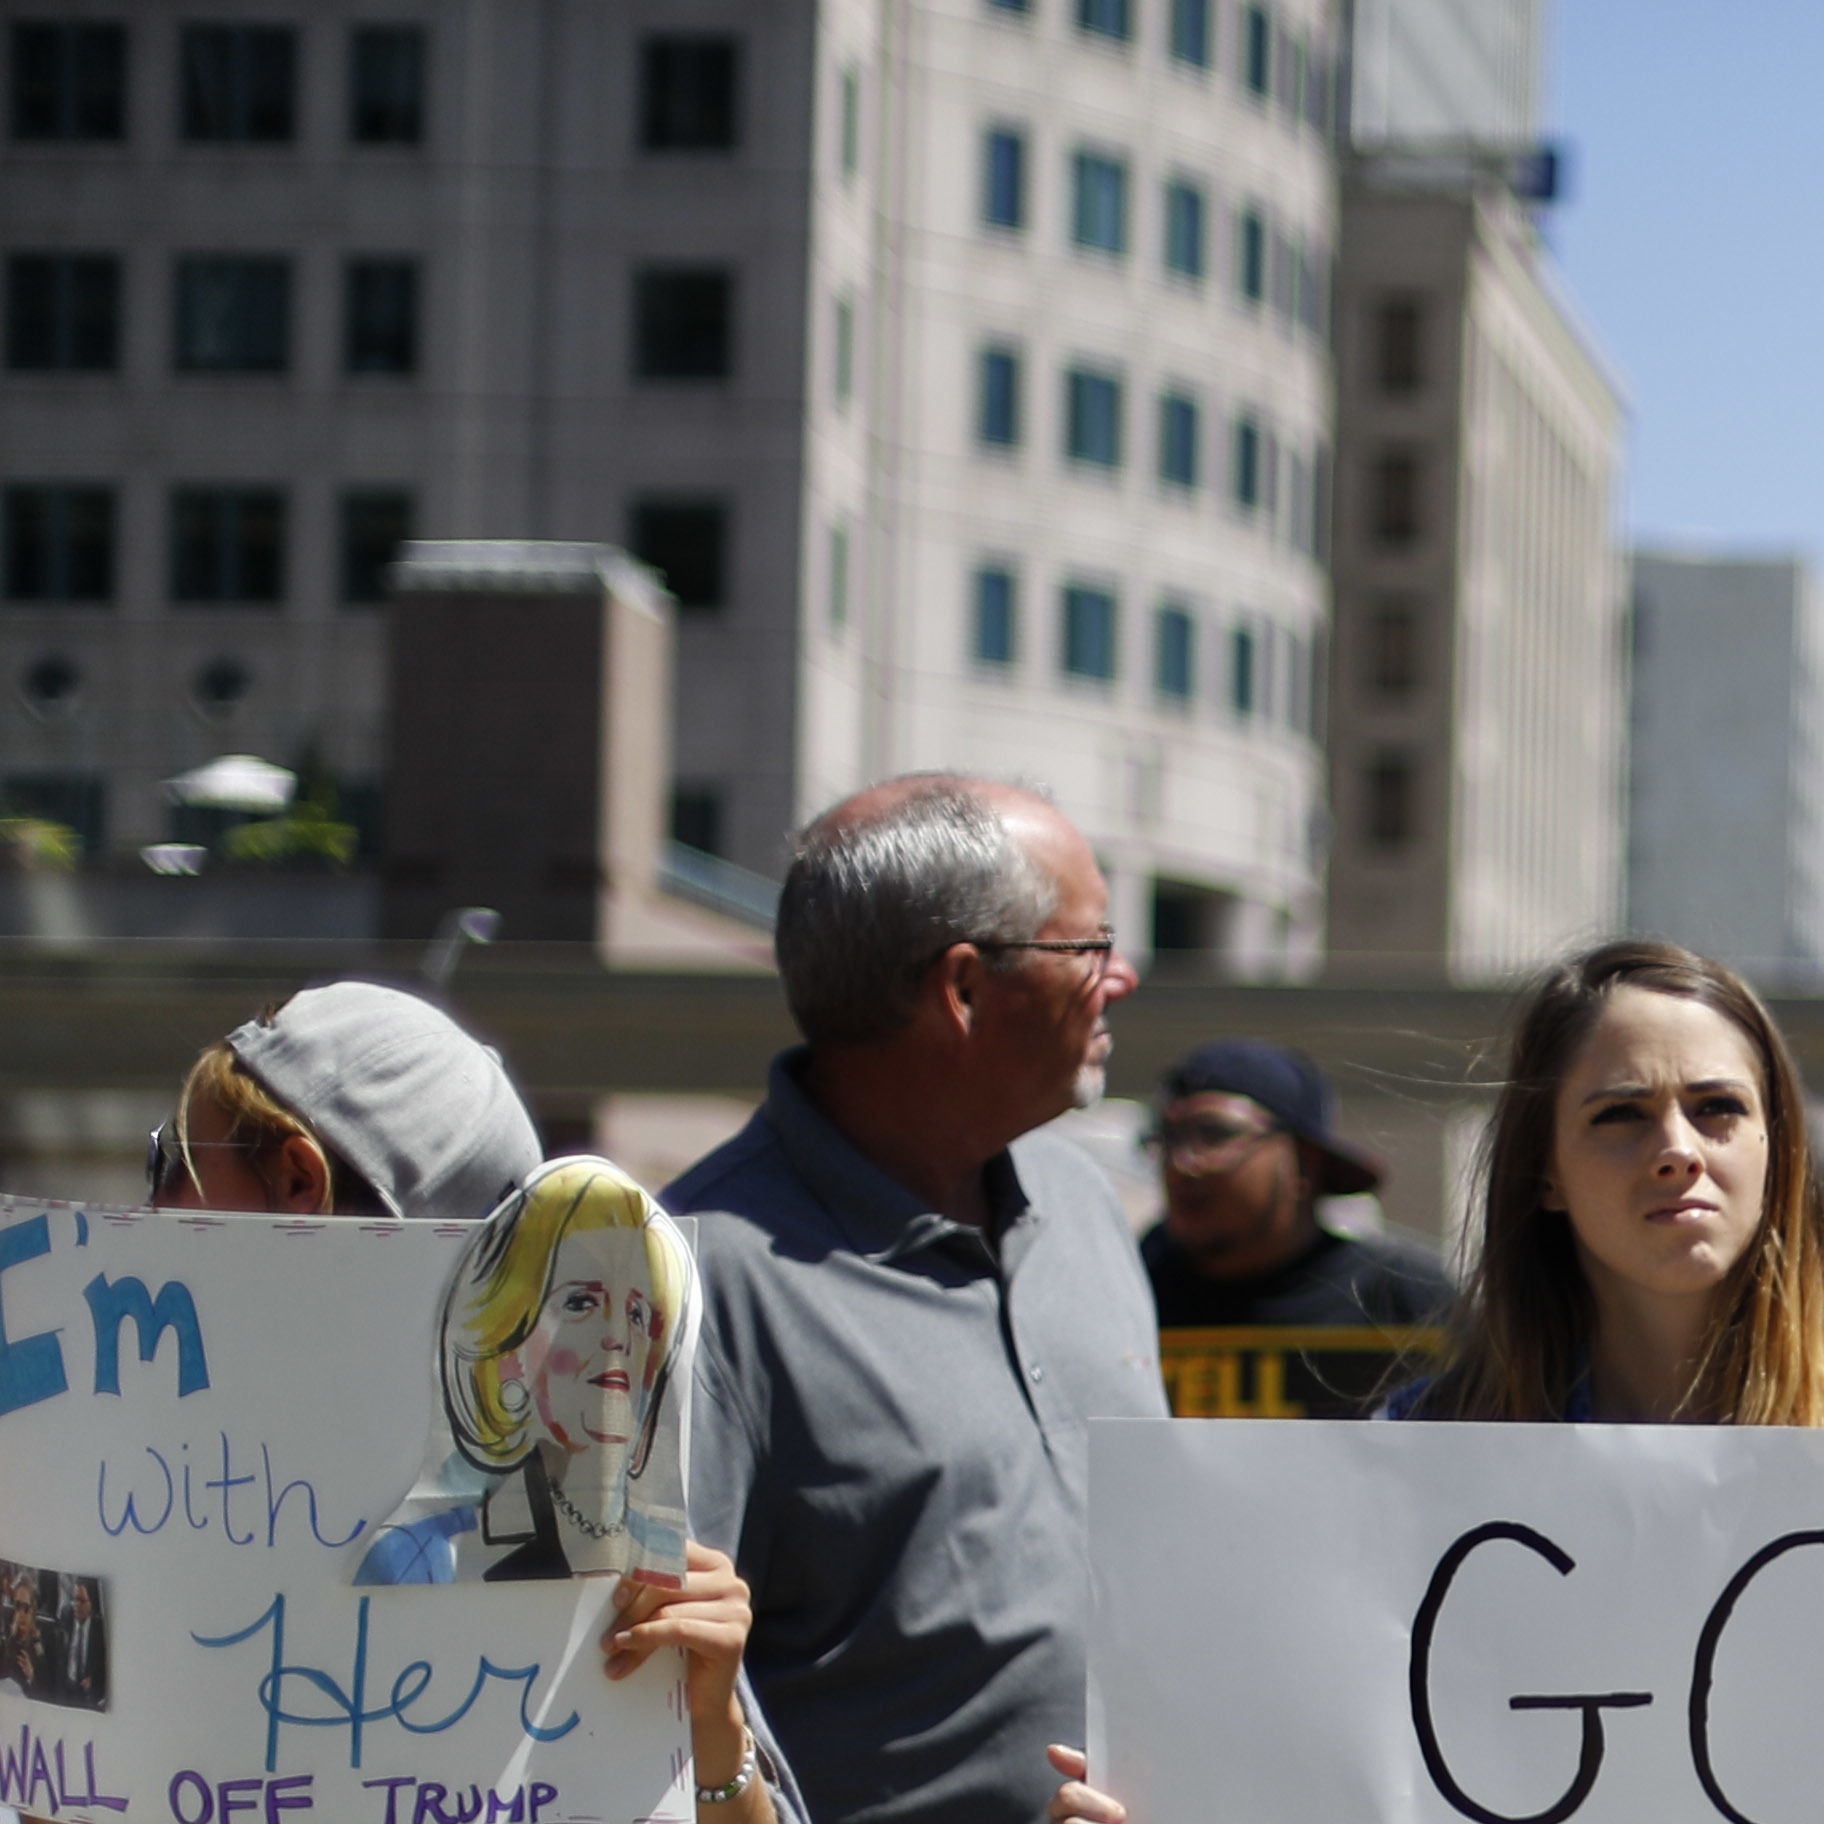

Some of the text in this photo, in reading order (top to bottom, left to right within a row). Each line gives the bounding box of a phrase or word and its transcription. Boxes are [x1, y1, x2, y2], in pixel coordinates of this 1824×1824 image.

[98, 1432, 368, 1548] with
[190, 1592, 580, 1772] Her
[0, 1724, 130, 1816] WALL
